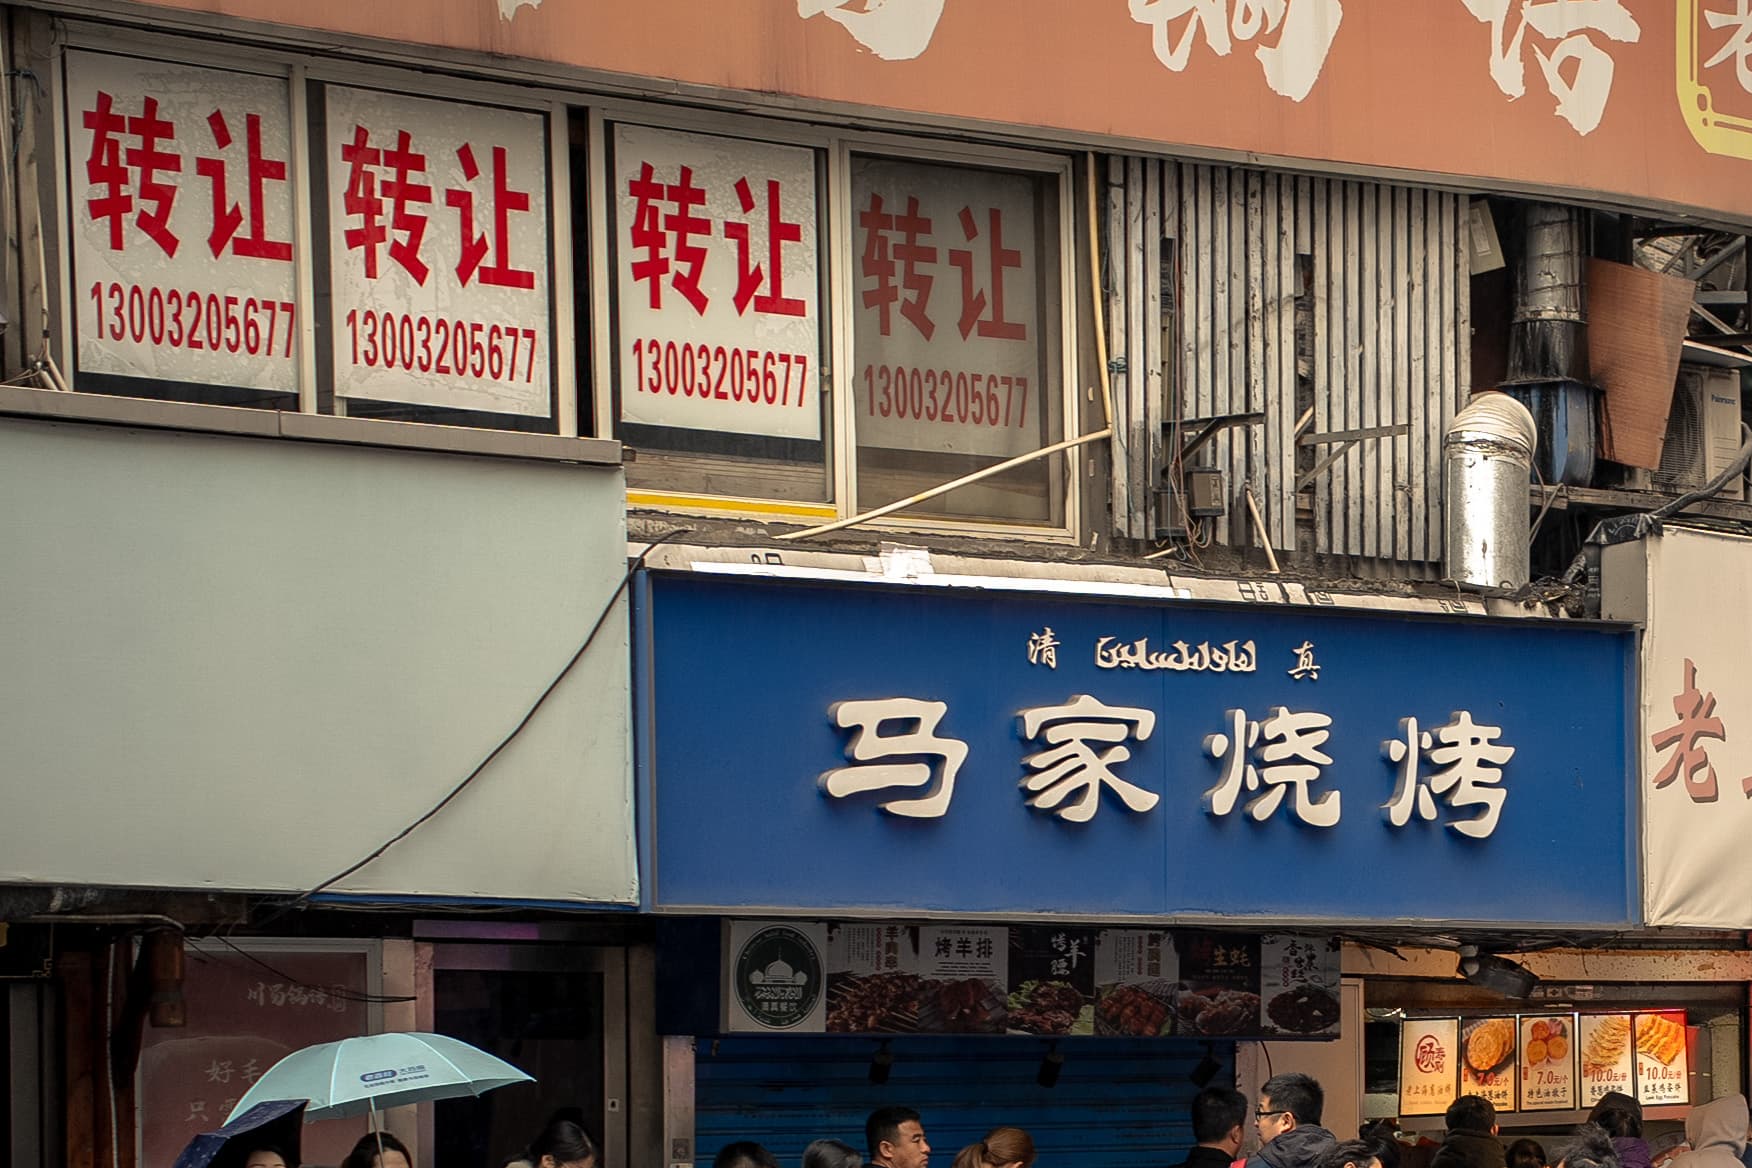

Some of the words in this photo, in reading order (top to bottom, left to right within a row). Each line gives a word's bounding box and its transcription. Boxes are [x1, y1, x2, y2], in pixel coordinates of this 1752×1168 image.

[83, 92, 293, 262] 转让
[342, 126, 535, 289] 转让
[629, 162, 806, 317] 转让
[860, 192, 1027, 342] 转让
[92, 282, 295, 358] 13003205677
[347, 309, 537, 384] 13003205677
[633, 338, 807, 408] 13003205677
[864, 364, 1028, 429] 13003205677
[1028, 626, 1060, 668] 清
[1288, 640, 1321, 680] 真
[820, 694, 1516, 839] 马家烧烤
[934, 935, 994, 959] 烤羊排
[1537, 1069, 1568, 1085] 7.0元/个
